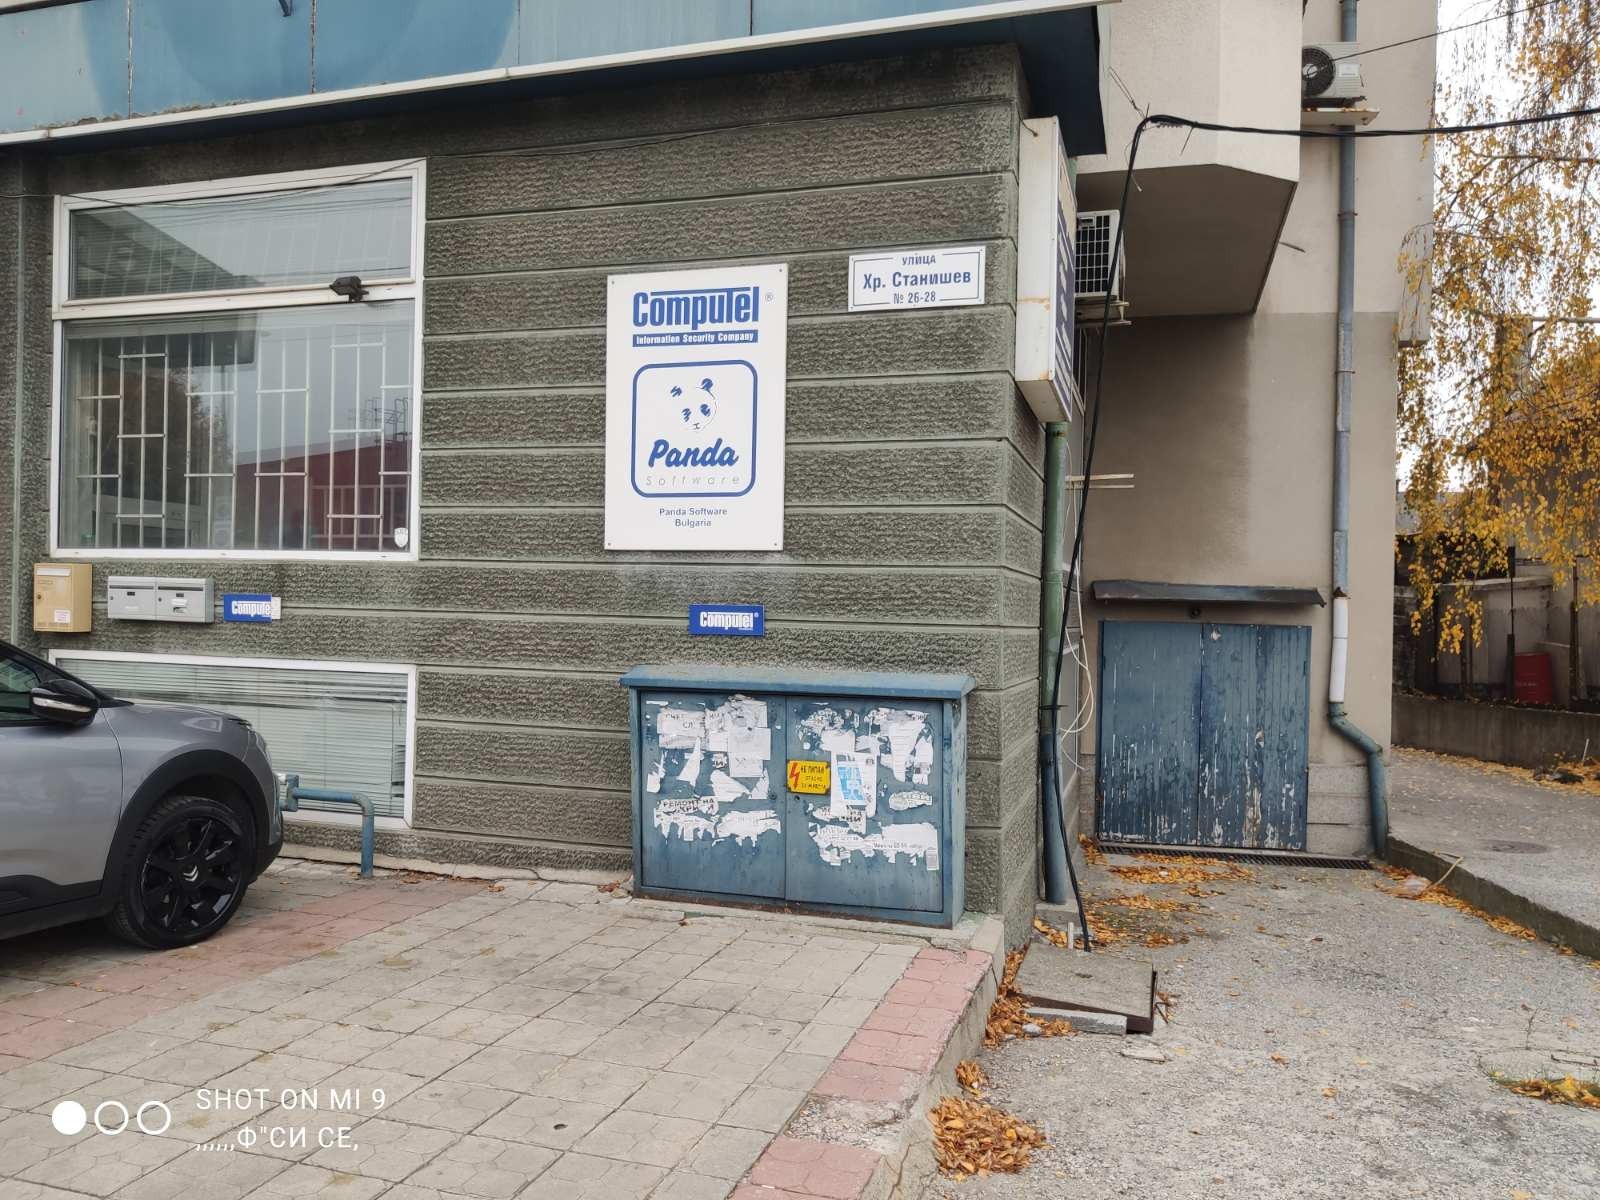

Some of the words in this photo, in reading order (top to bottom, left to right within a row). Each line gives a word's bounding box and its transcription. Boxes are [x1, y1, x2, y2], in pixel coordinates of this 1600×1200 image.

[863, 274, 886, 292] Хр.
[892, 271, 971, 288] Станишев
[893, 293, 904, 304] №
[908, 291, 936, 303] 26-28
[636, 334, 681, 345] Information
[682, 332, 715, 344] Security
[718, 331, 754, 343] Company
[648, 438, 739, 468] Panda
[645, 475, 740, 487] Software
[659, 508, 687, 516] Panda
[689, 507, 728, 516] Software
[675, 518, 712, 528] Bulgaria
